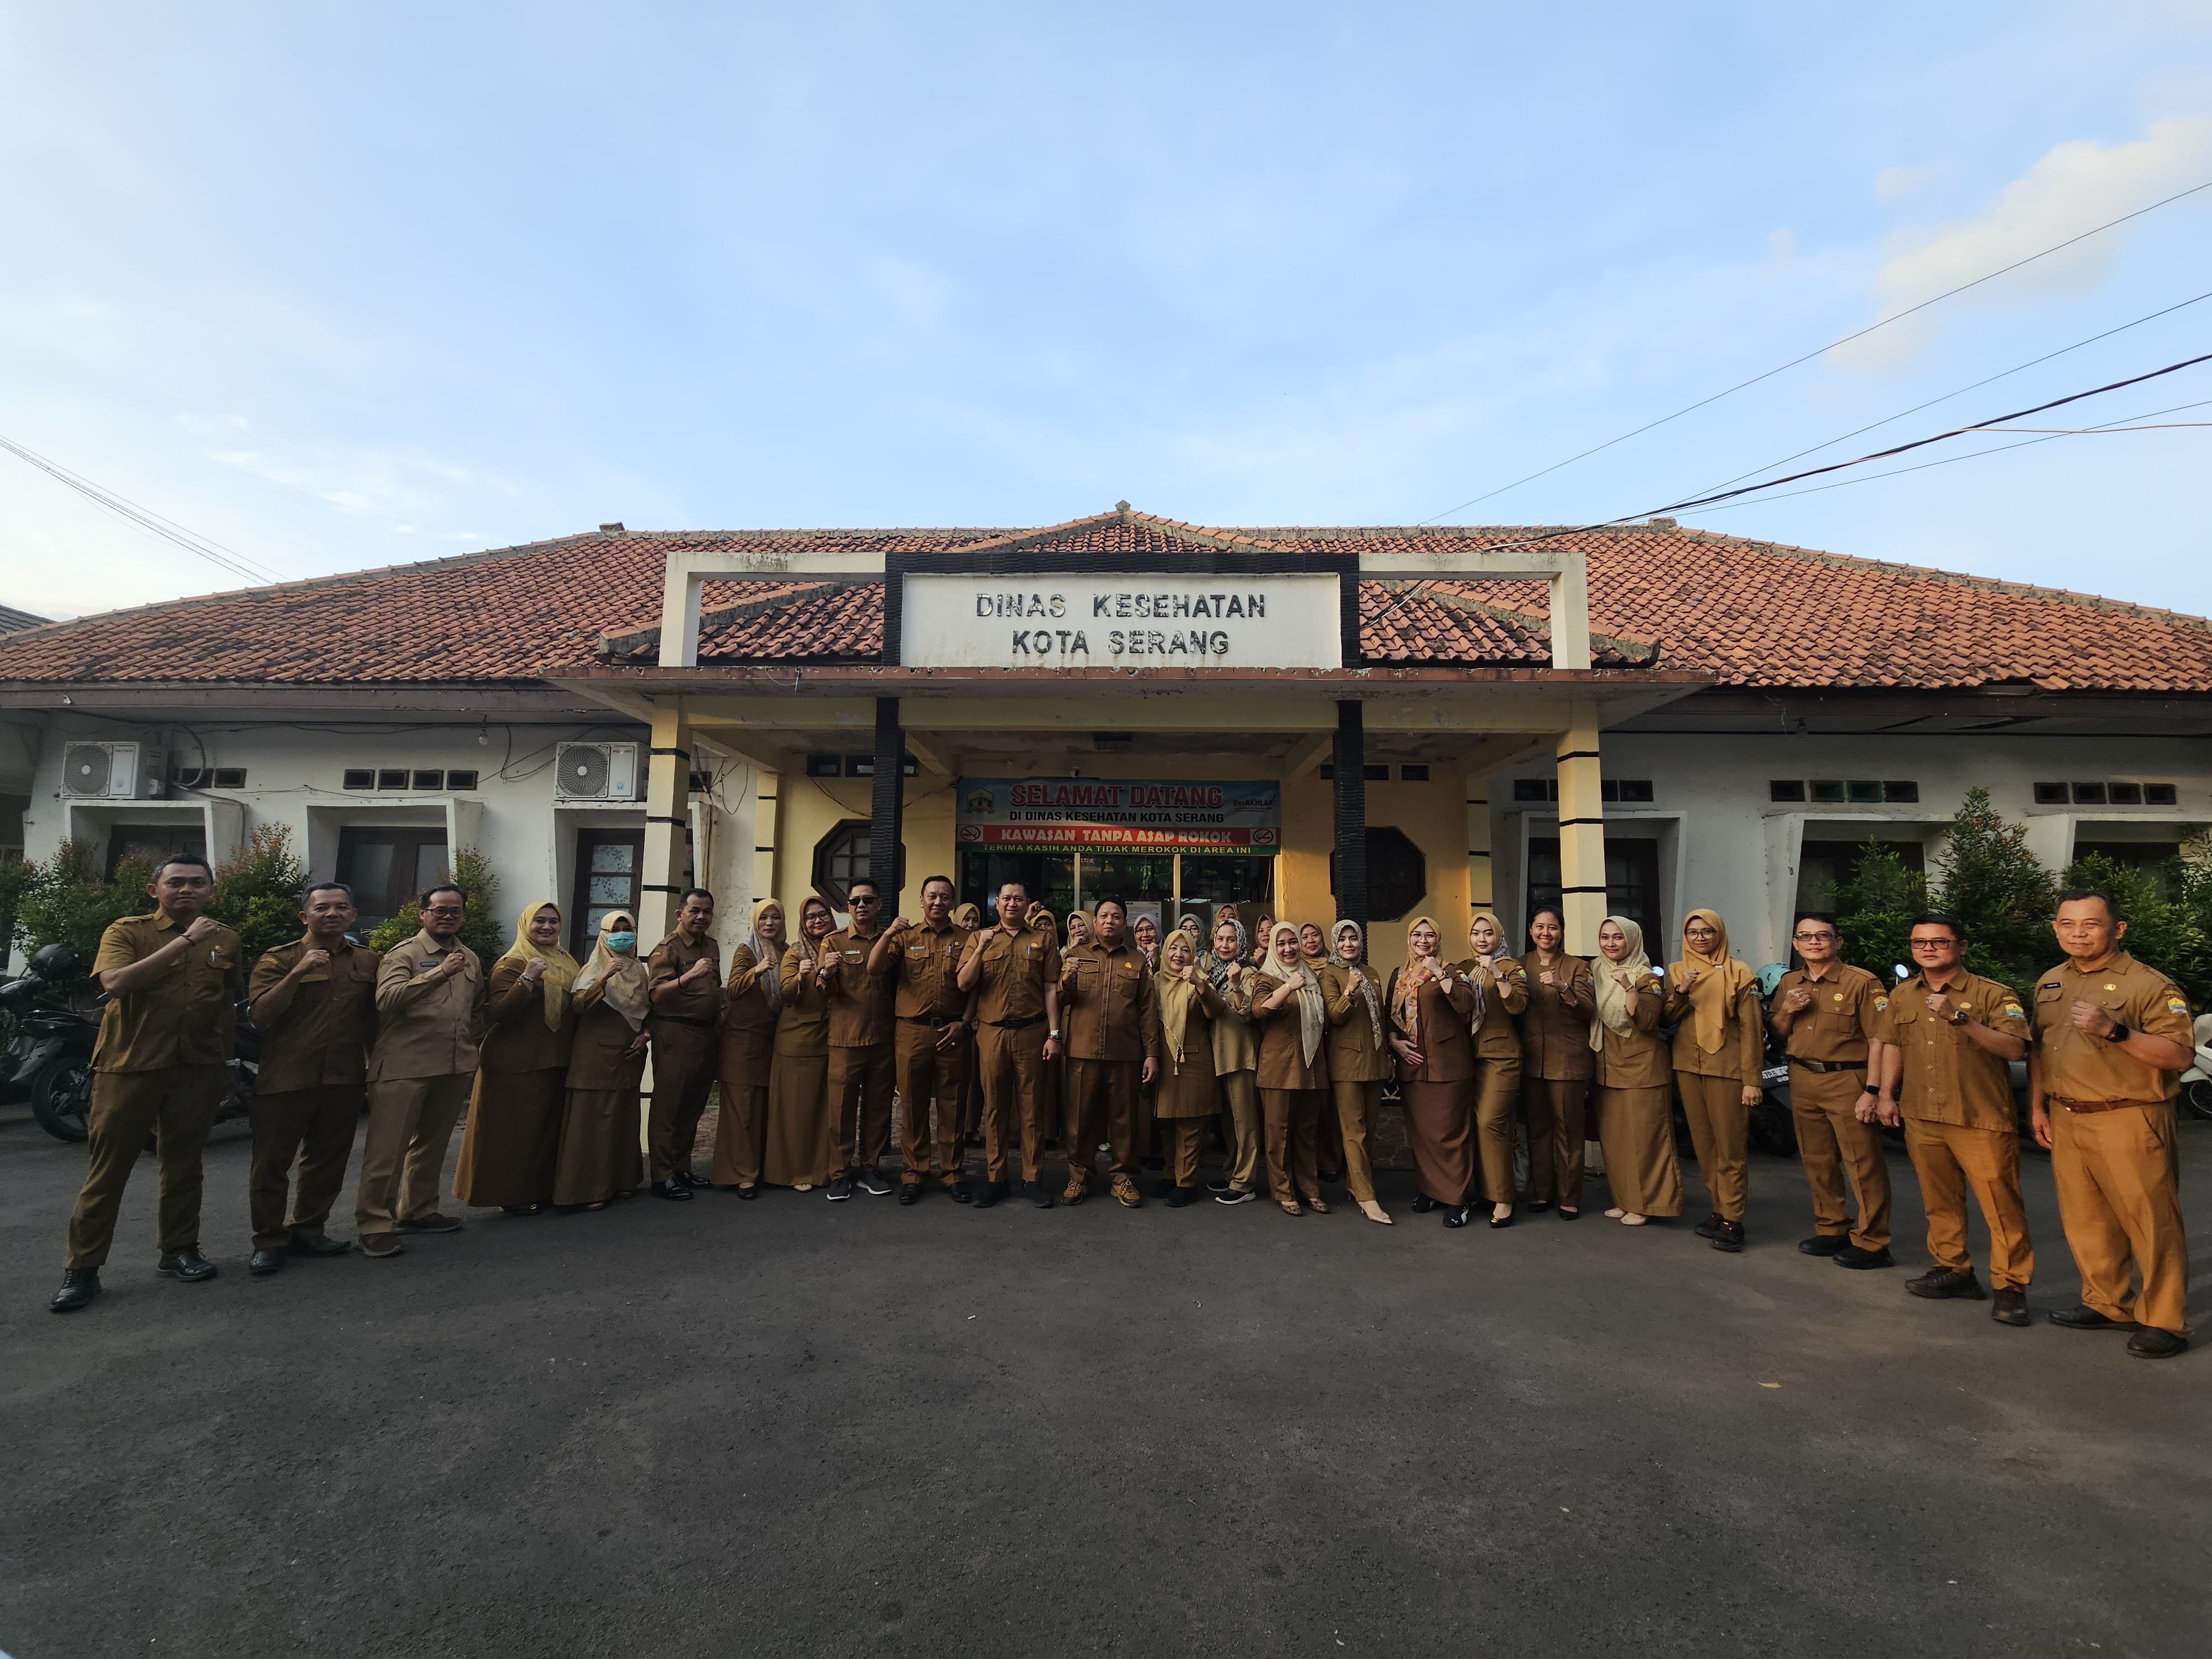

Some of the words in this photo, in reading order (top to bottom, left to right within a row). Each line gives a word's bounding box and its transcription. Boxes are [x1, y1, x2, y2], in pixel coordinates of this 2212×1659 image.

[976, 593, 1065, 617] DINAS
[1093, 593, 1265, 618] KESEHATAN
[1013, 630, 1089, 654] KOTA
[1108, 630, 1230, 654] SERANG
[1010, 784, 1124, 807] SELAMAT
[1129, 785, 1224, 808] DATANG
[1010, 812, 1021, 821] DI
[1025, 812, 1062, 821] DINAS
[1066, 812, 1136, 822] KESEHATAN
[1140, 813, 1172, 822] KOTA
[1175, 813, 1224, 823] SERANG
[1001, 829, 1076, 842] KAWASAN
[1083, 830, 1133, 842] TANPA
[1136, 830, 1175, 842] ASAP
[1178, 831, 1232, 843] ROKOK
